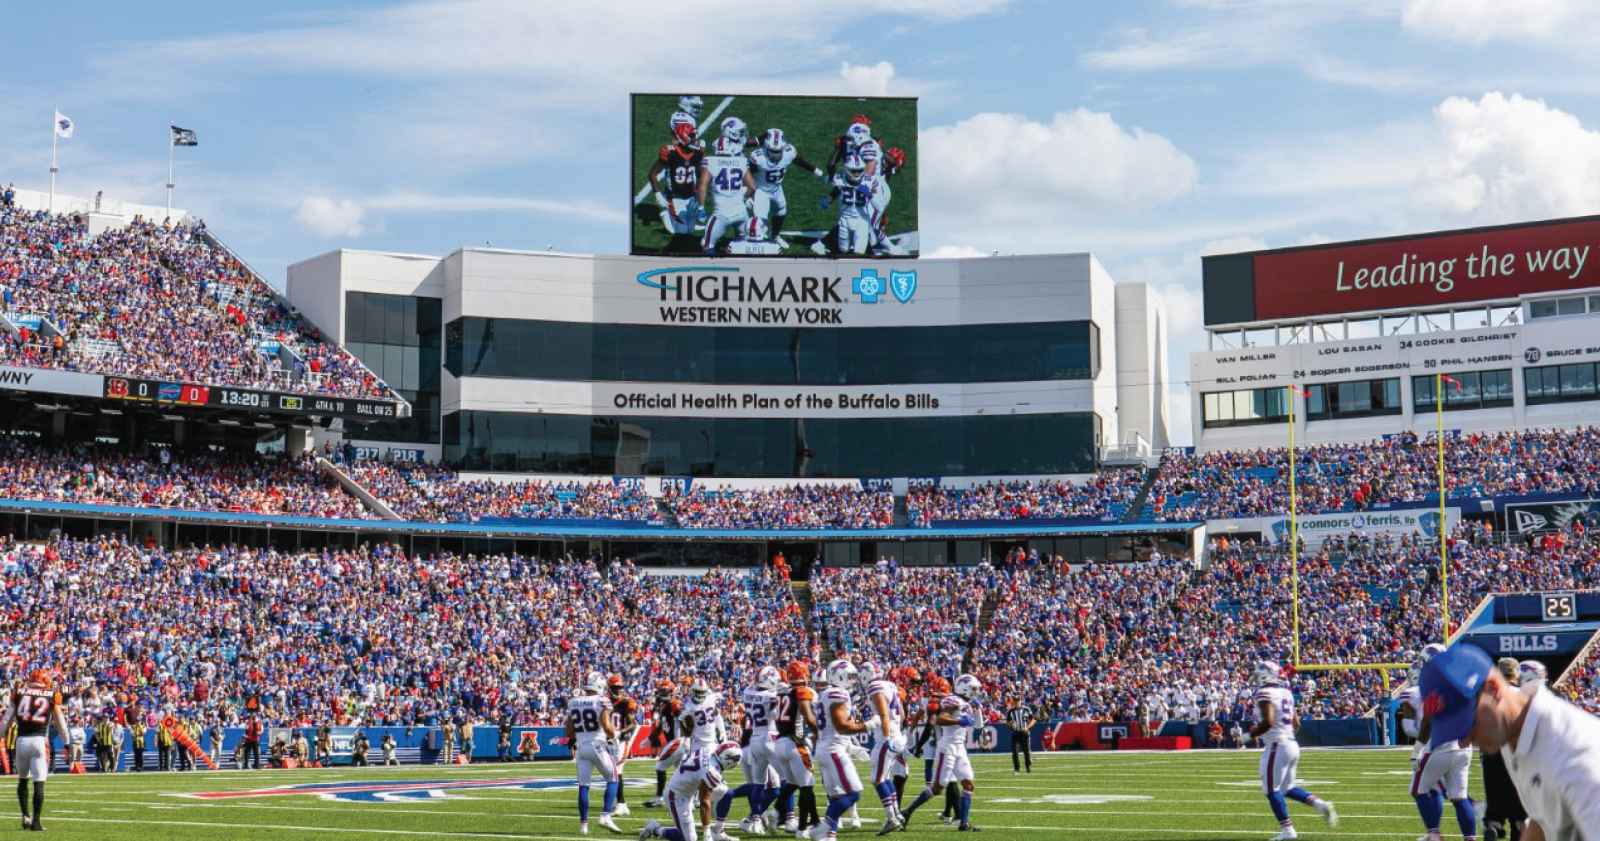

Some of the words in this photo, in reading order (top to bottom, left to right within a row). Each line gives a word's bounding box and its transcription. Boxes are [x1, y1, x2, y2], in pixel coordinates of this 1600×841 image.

[715, 168, 742, 190] 42
[1336, 253, 1457, 292] Leading
[1466, 244, 1515, 280] the
[1526, 245, 1590, 279] way
[659, 275, 843, 303] HIGHMARK
[659, 306, 741, 324] WESTERN
[748, 307, 789, 324] NEW
[796, 307, 842, 324] YORK
[1318, 347, 1339, 355] LOU
[139, 383, 147, 396] 0
[190, 388, 199, 401] 0
[220, 391, 259, 406] 13:20
[613, 393, 677, 409] Official
[682, 393, 737, 409] Health
[743, 393, 780, 409] Plan
[784, 393, 802, 409] of
[806, 393, 833, 409] the
[838, 393, 901, 409] Buffalo
[905, 393, 939, 409] Bills
[356, 447, 378, 460] 217
[1302, 518, 1349, 529] connors
[1547, 597, 1571, 616] 25
[1500, 635, 1558, 652] BILLS
[17, 695, 49, 722] 42
[694, 706, 717, 726] 33
[570, 709, 600, 732] 28
